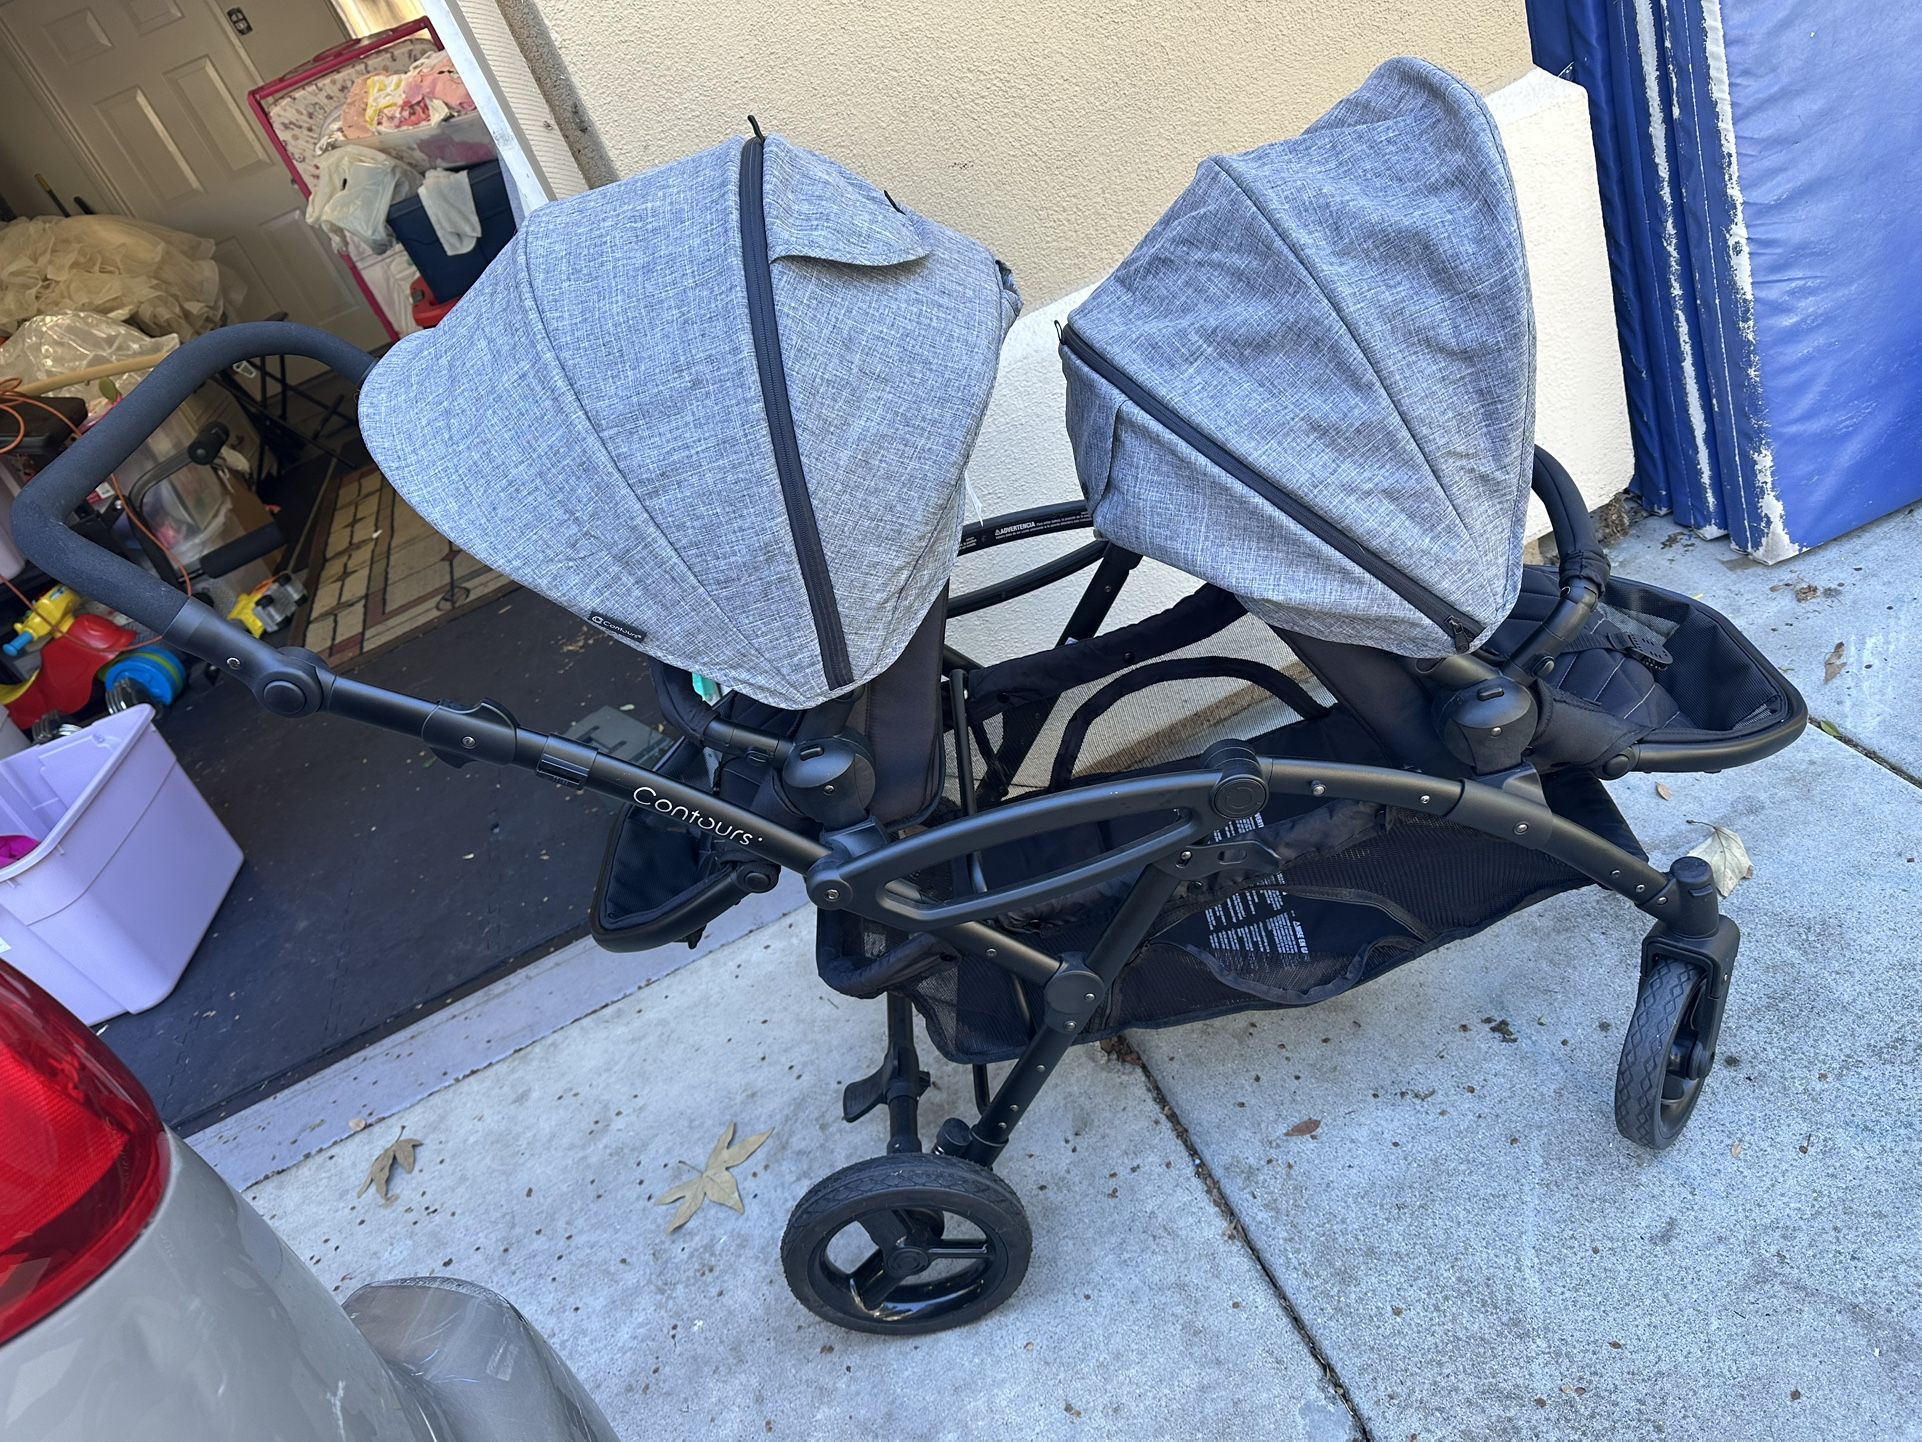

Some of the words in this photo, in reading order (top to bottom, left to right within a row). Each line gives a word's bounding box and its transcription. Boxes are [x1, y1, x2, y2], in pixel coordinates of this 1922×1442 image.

[1000, 521, 1035, 534] ADVERTENCIA
[603, 620, 640, 639] Contours
[633, 786, 753, 845] Contours
